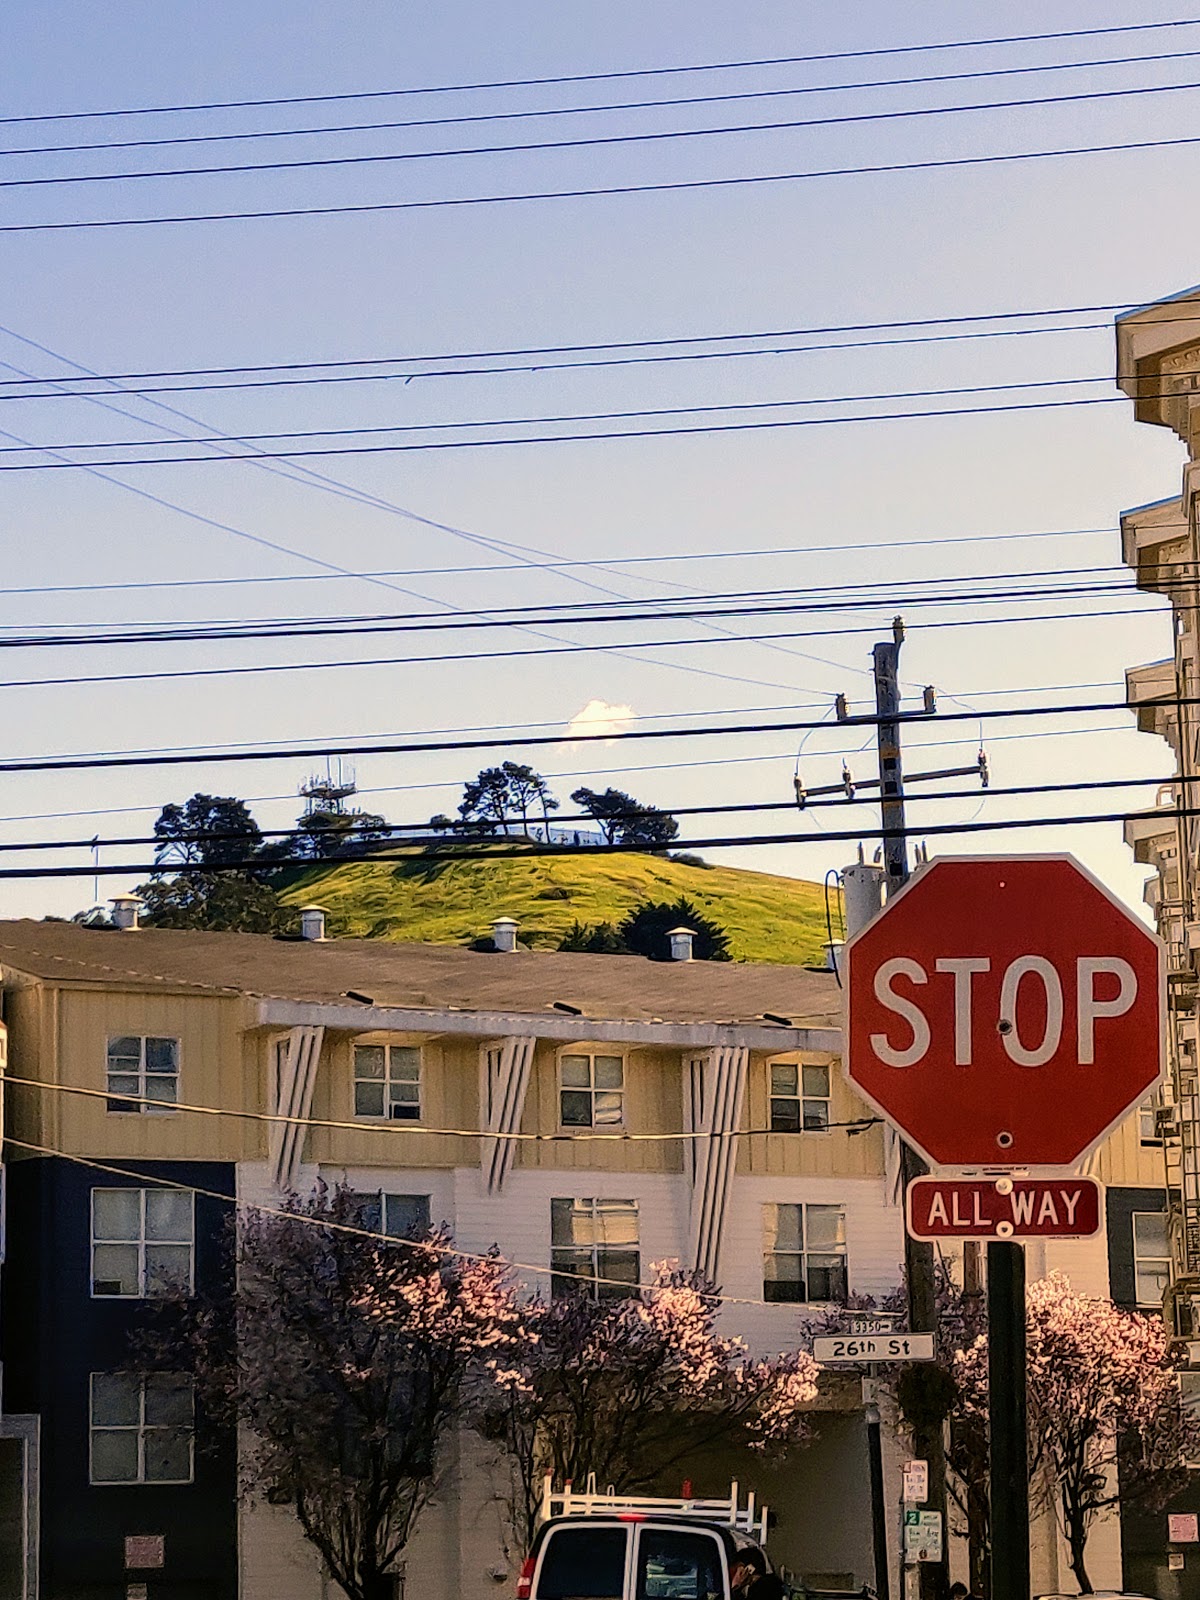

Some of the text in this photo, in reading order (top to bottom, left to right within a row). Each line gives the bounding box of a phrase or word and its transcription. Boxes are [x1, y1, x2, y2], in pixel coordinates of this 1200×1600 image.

[869, 954, 1138, 1068] STOP
[927, 1189, 1082, 1227] ALL WAY
[855, 1321, 881, 1333] 3350
[833, 1339, 911, 1357] 26th St
